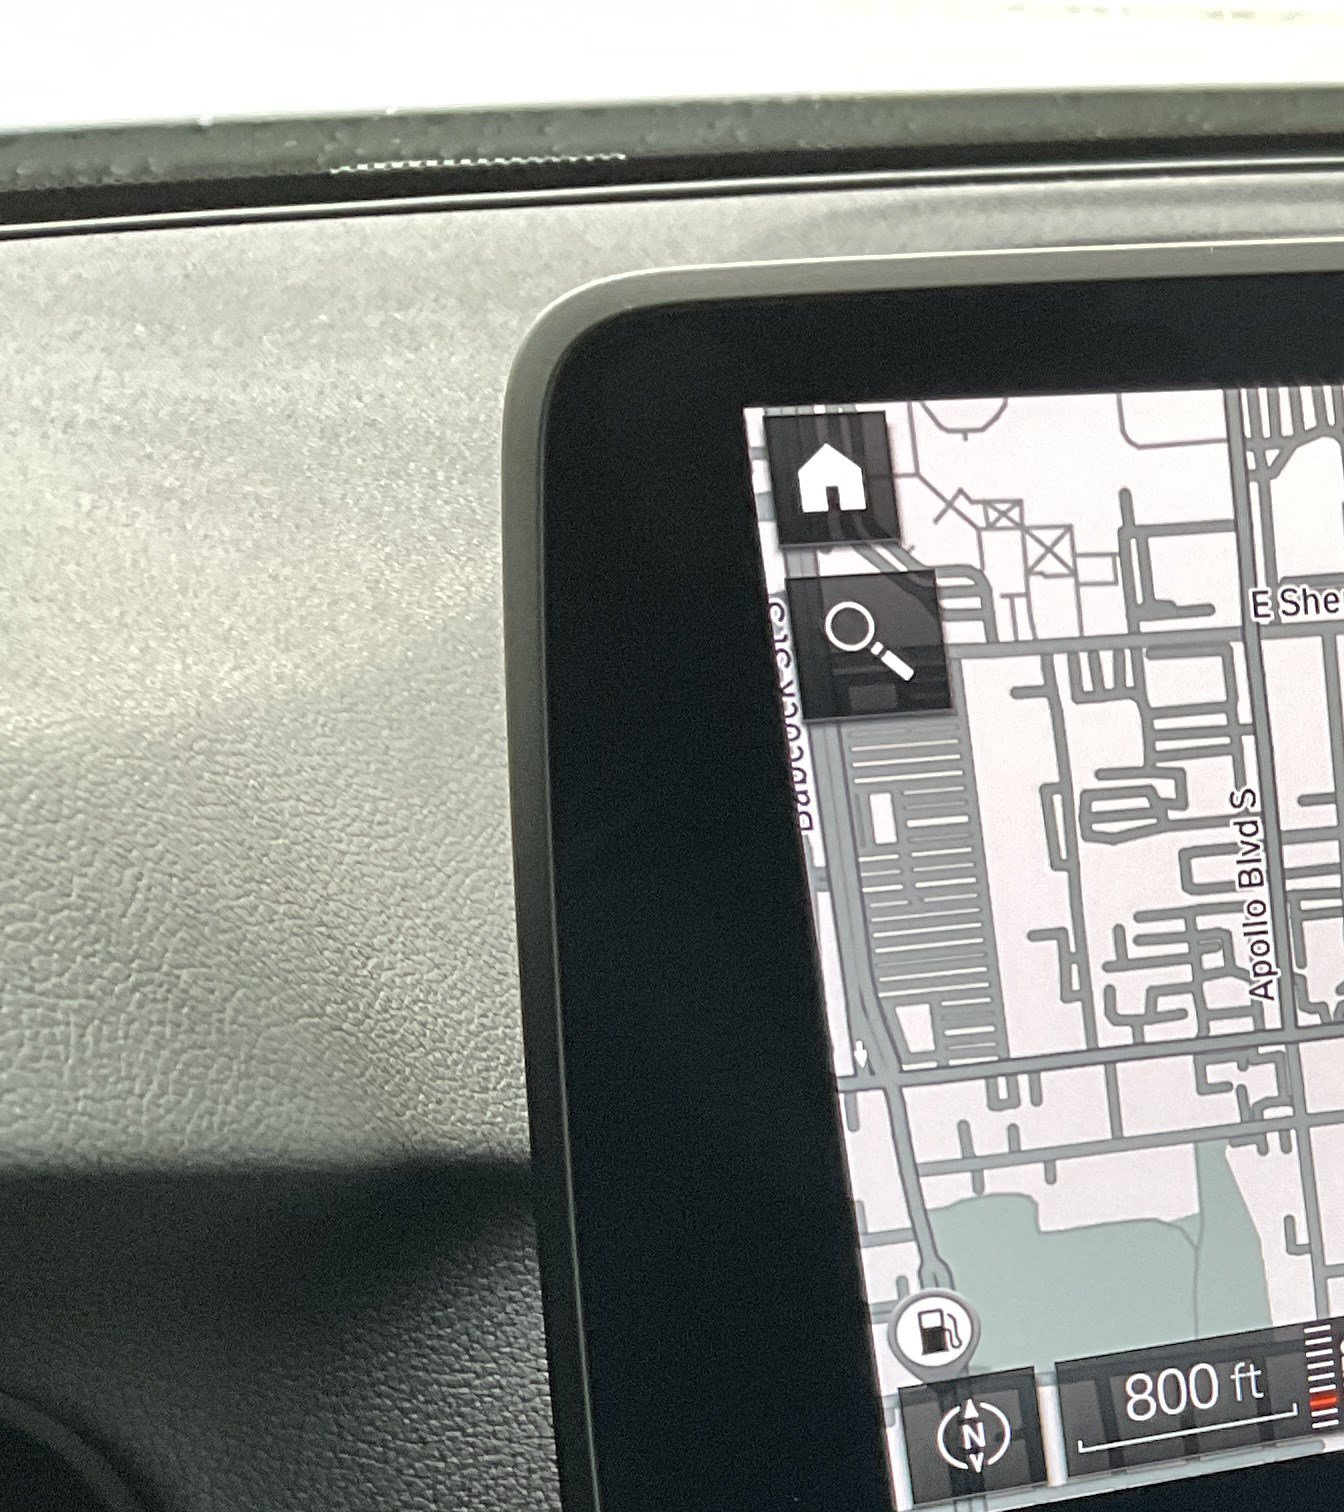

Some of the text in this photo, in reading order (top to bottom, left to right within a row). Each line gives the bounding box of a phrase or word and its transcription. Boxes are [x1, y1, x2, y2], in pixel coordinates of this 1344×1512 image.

[1251, 590, 1272, 619] E
[1229, 787, 1279, 1001] Apollo Blvd S
[1124, 1361, 1266, 1423] 800 ft
[961, 1423, 987, 1451] N
